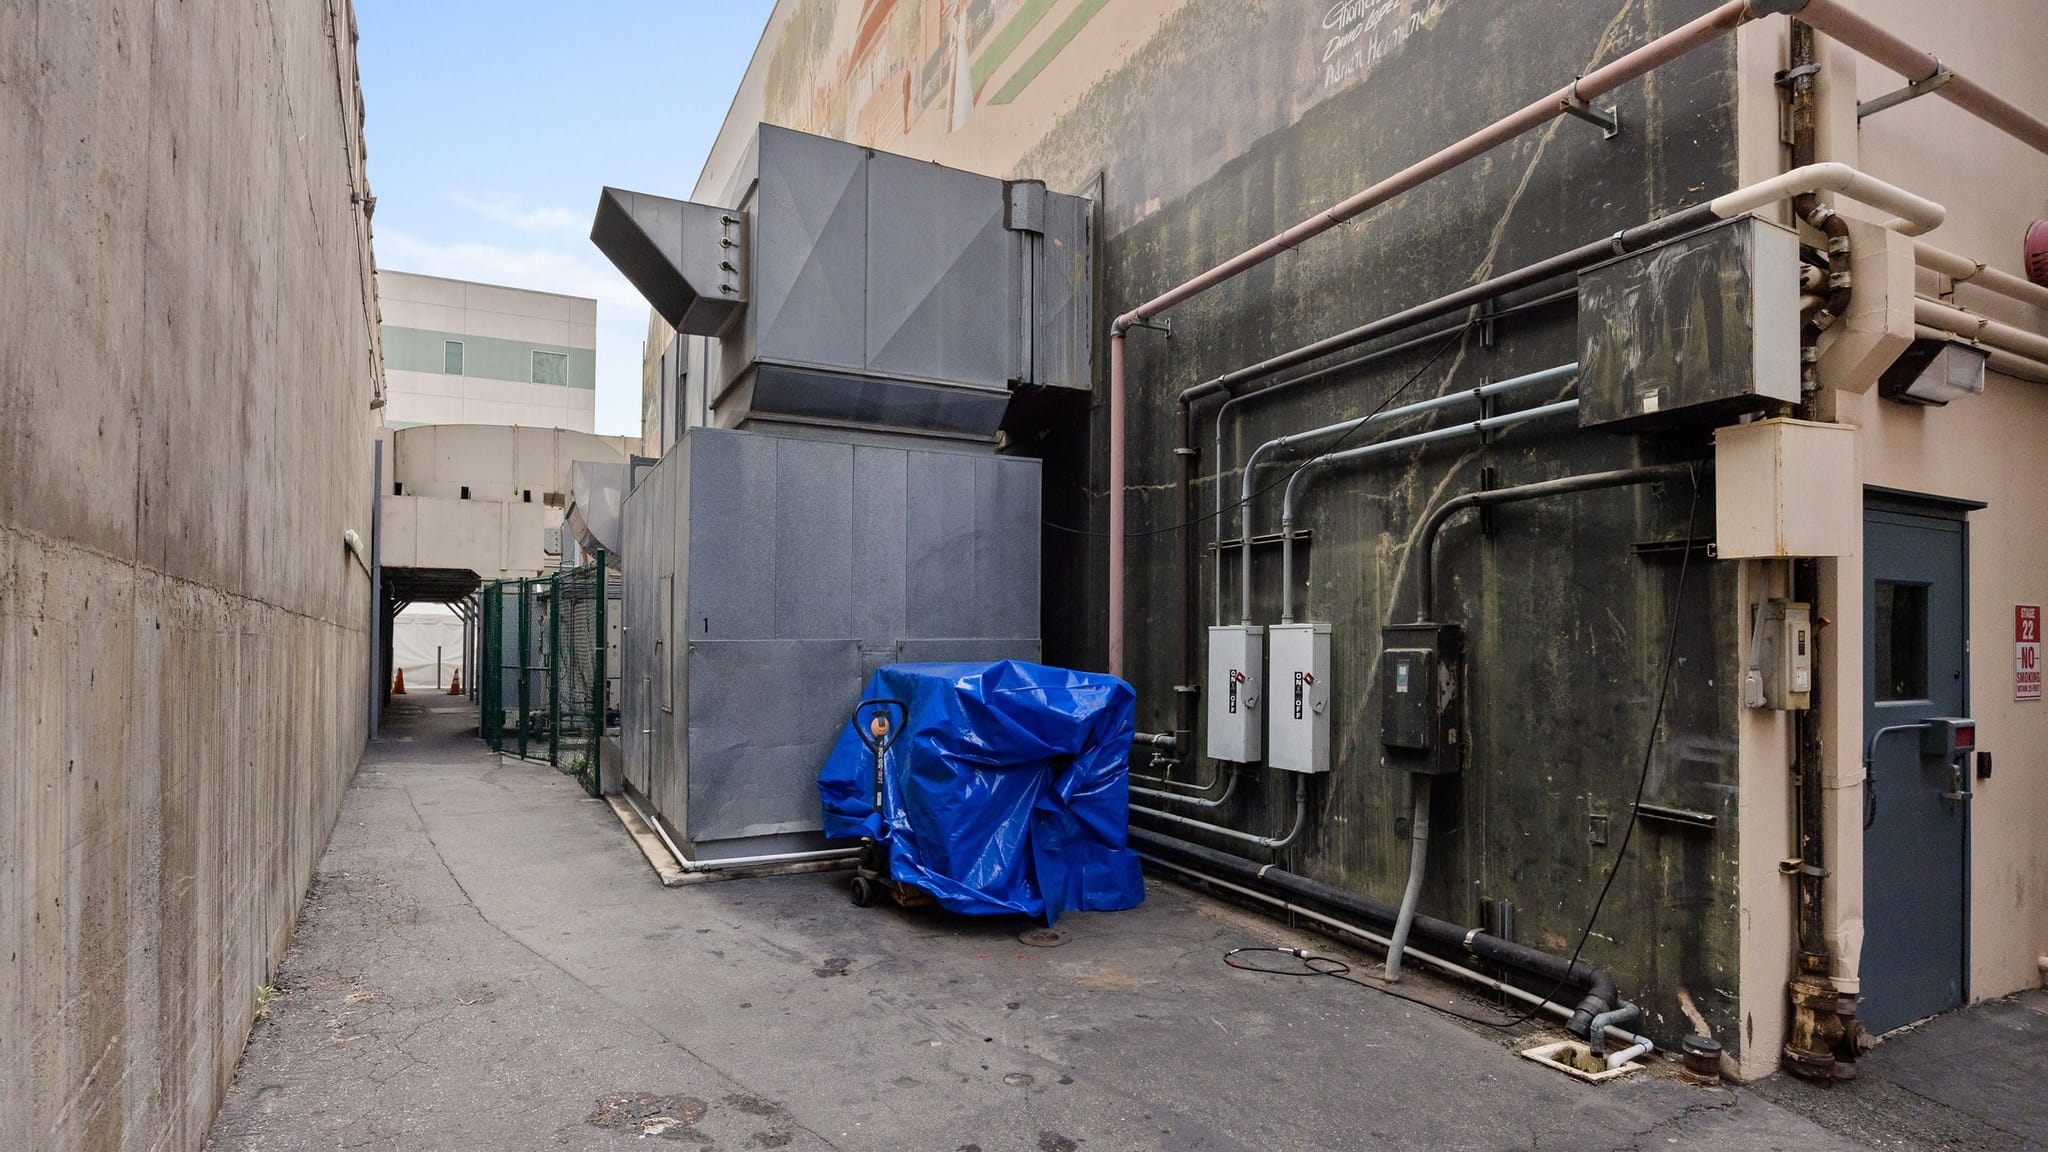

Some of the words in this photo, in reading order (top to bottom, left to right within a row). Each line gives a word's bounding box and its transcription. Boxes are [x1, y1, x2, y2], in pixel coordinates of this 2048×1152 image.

[2021, 608, 2035, 618] STAGE
[2022, 620, 2033, 640] 22
[2021, 647, 2034, 669] NO
[1296, 673, 1302, 686] ON
[2016, 672, 2040, 683] SMOKING
